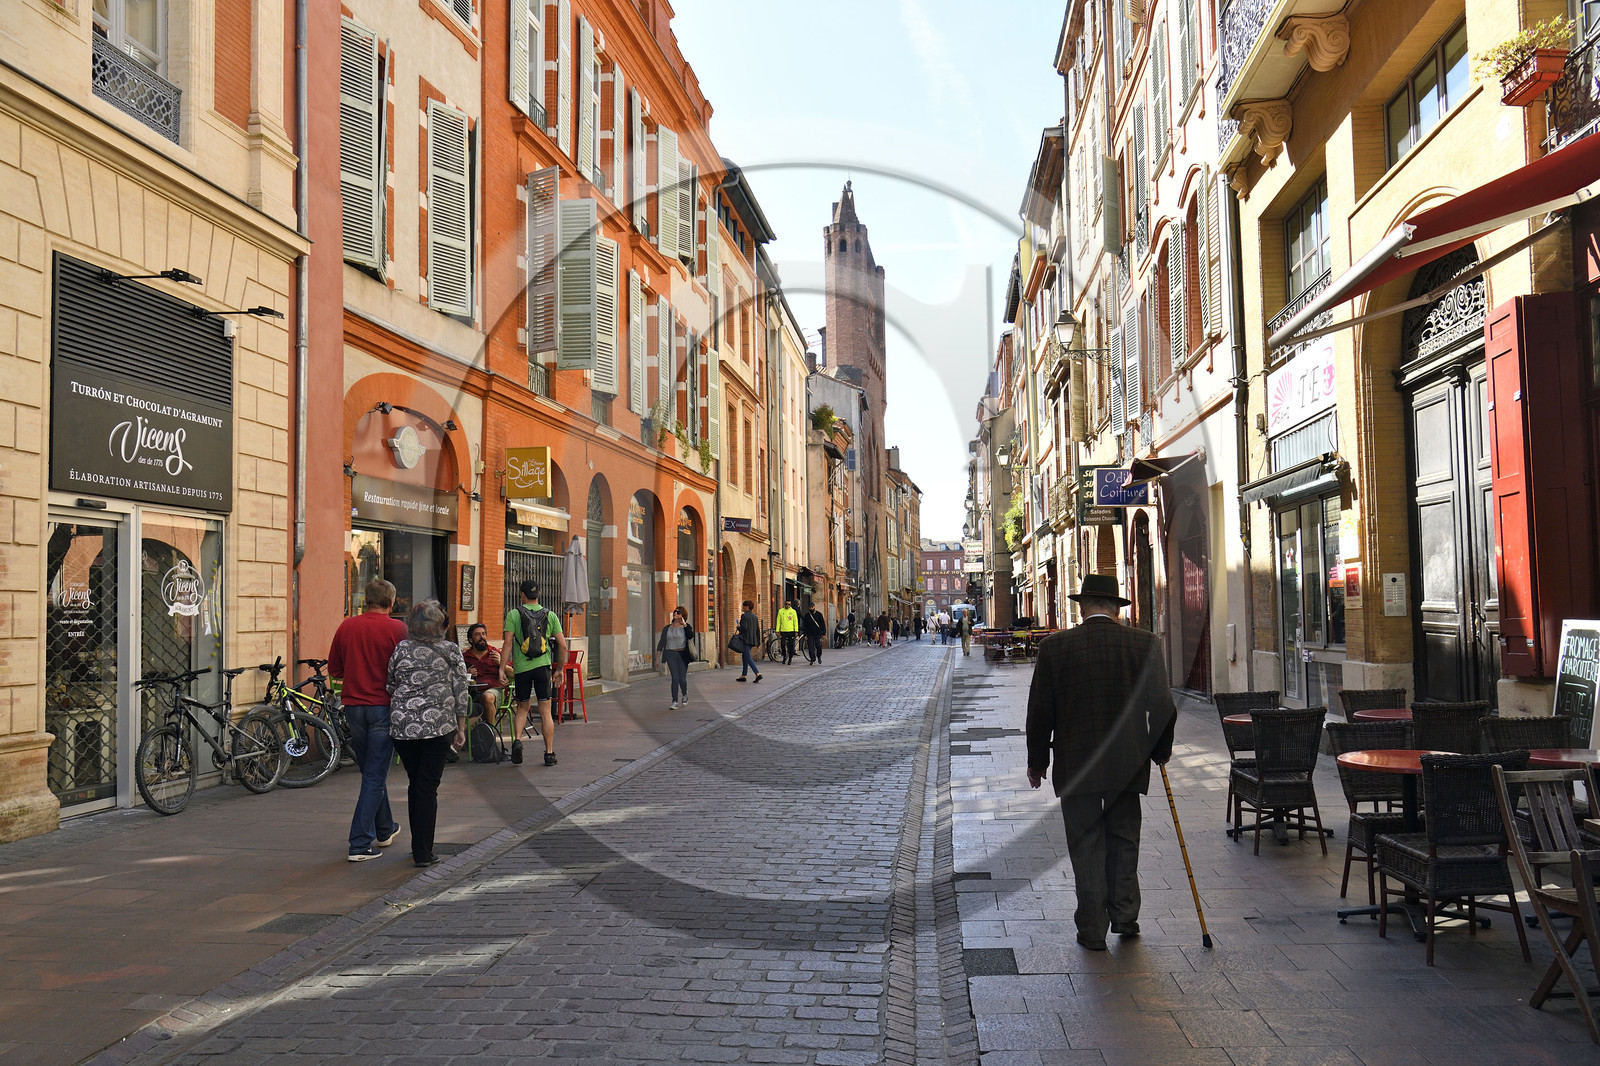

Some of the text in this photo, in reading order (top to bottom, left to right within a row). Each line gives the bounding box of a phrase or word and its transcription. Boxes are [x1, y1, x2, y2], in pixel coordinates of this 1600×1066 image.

[71, 381, 222, 428] TURRÓN ET CHOCOLAT D'AGRAMUNT
[108, 416, 193, 476] Vicens
[69, 469, 223, 501] ÉLABORATION ARTISANALE DEPUIS 1775
[1099, 485, 1145, 502] Coiffure
[364, 491, 400, 507] Restauration
[401, 500, 418, 510] rapide
[430, 504, 435, 513] et
[435, 505, 450, 515] locale
[1565, 635, 1598, 661] FROMAGE
[1558, 691, 1586, 716] VENTE
[1570, 718, 1591, 742] ORTER
